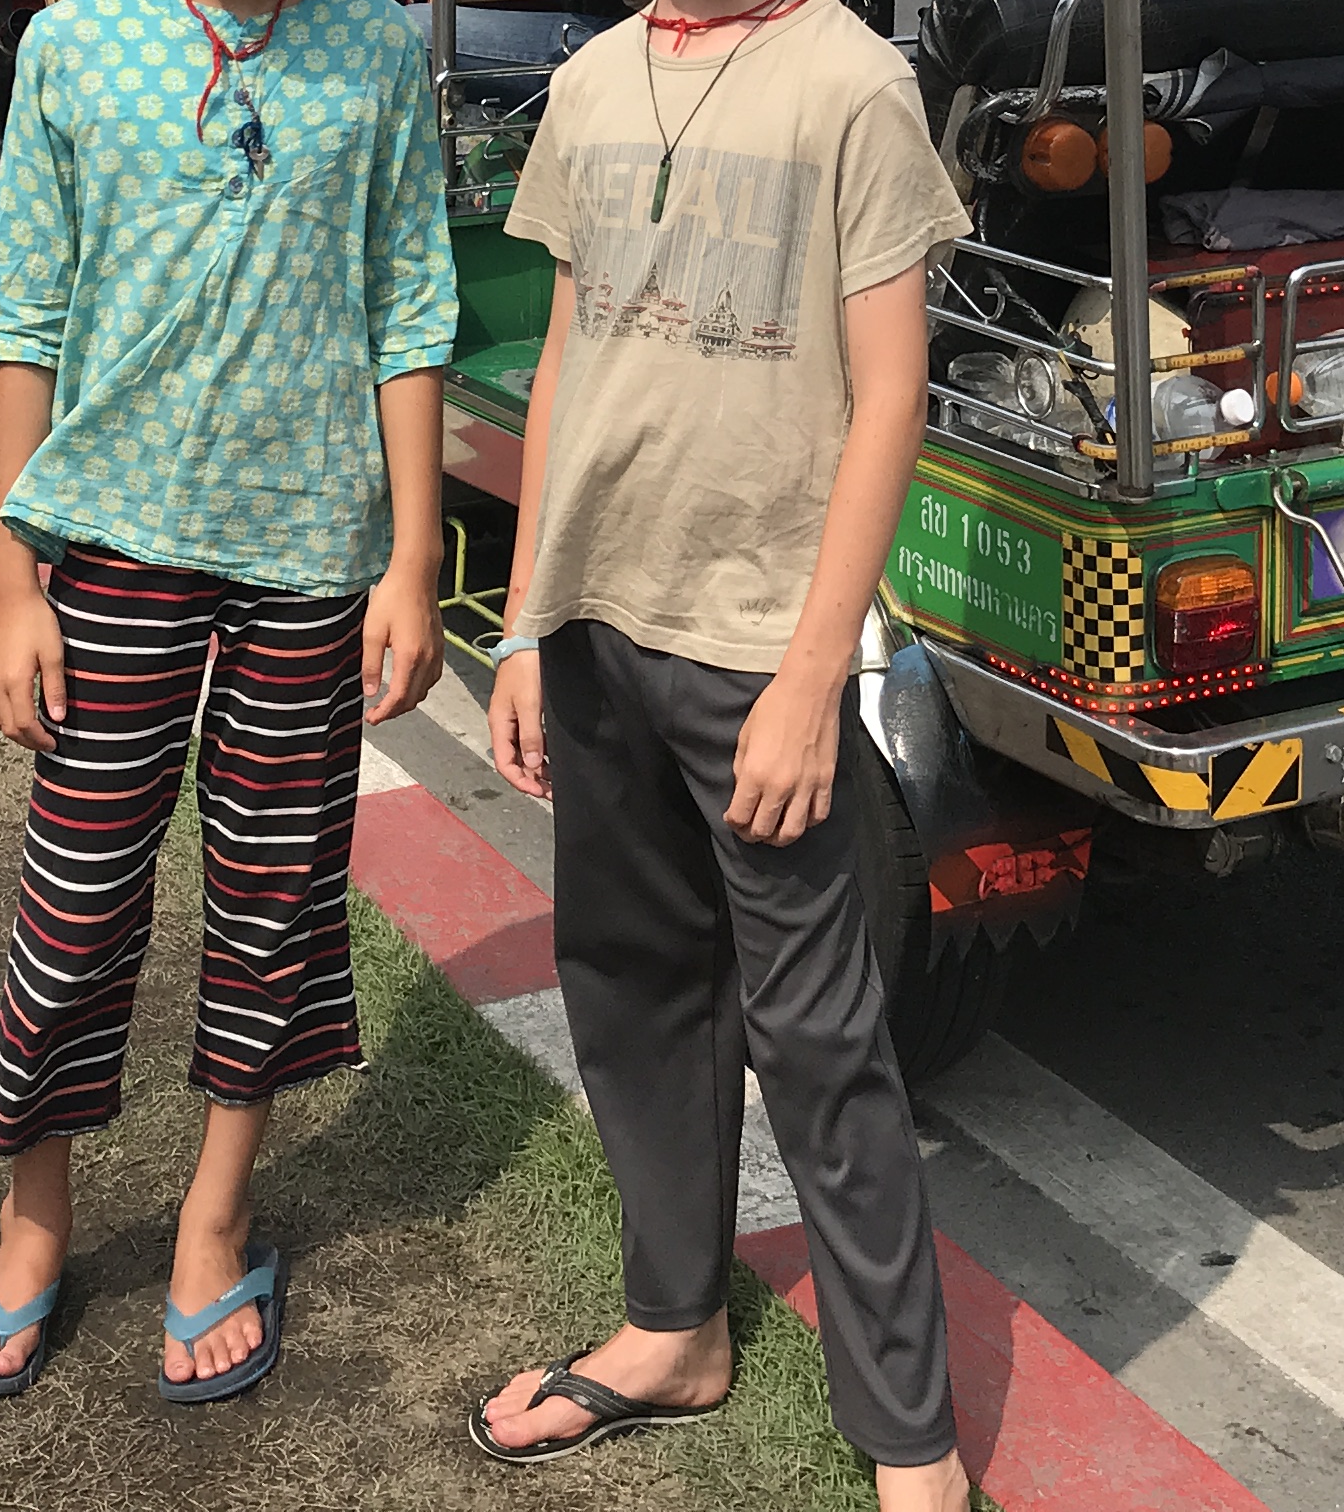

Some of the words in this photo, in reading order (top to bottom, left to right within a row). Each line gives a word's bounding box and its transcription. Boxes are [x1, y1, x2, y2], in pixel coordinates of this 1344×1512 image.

[920, 493, 948, 539] สข
[961, 513, 1032, 575] 1053
[898, 545, 1057, 643] กรุงเทพมหานคร
